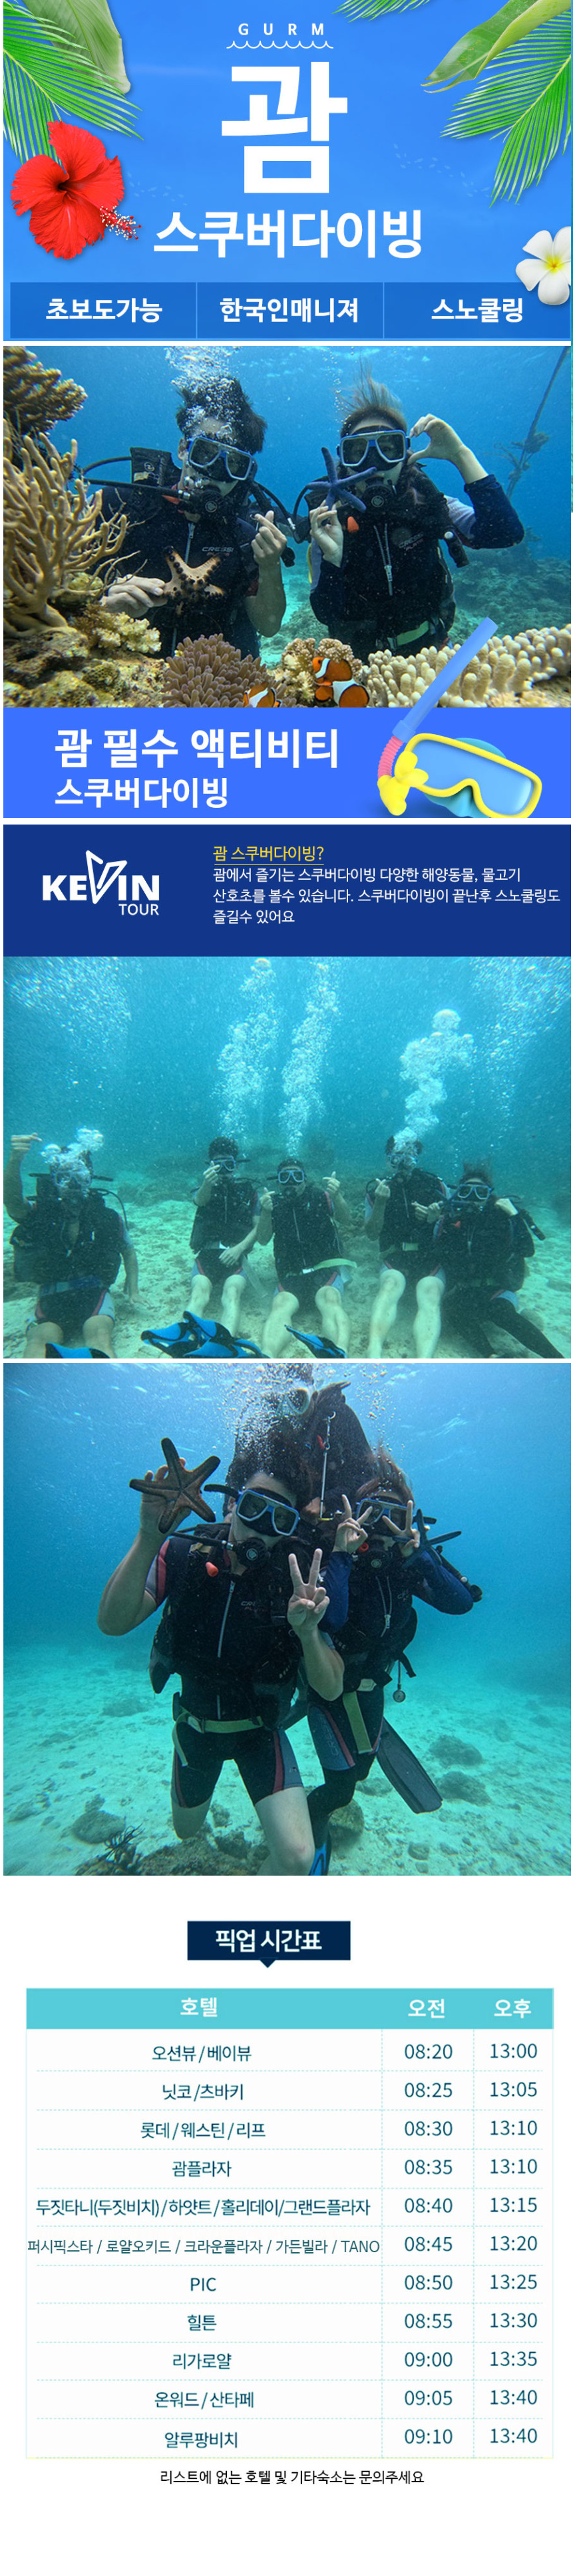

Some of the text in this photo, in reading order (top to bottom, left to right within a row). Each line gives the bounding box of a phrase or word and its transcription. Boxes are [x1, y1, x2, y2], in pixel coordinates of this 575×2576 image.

[238, 23, 324, 36] GURM
[222, 61, 348, 193] 괌
[153, 209, 422, 259] 스쿠버다이빙
[46, 297, 163, 323] 초보도가능
[220, 297, 358, 323] 한국인매니져
[431, 297, 524, 323] 스노쿨링
[55, 729, 338, 769] 괌 필수 액티비티
[55, 777, 228, 809] 스쿠버다이빙
[213, 846, 324, 862] 괌 스쿠버다이빙?
[42, 850, 160, 904] KEVIN
[213, 868, 520, 882] 괌에서 즐기는 스쿠버다이빙 다양한 해양동물, 물고기
[213, 888, 560, 904] 산호초를 볼수 있습니다. 스쿠버다이빙이 끝난후 스노쿨링도
[118, 904, 159, 916] TOUR
[213, 910, 295, 924] 즐길수 있어요
[216, 1929, 322, 1952] 픽업 시간표
[180, 1997, 218, 2017] 호텔
[407, 1999, 445, 2019] 오전
[494, 1999, 532, 2019] 오후
[404, 2043, 453, 2059] 08:20
[489, 2043, 538, 2059] 13:00
[404, 2082, 453, 2098] 08:25
[489, 2081, 538, 2097] 13:05
[404, 2121, 453, 2136] 08:30
[489, 2120, 538, 2136] 13:10
[171, 2160, 232, 2178] 괌플라자
[404, 2159, 453, 2175] 08:35
[489, 2158, 538, 2174] 13:10
[404, 2198, 453, 2214] 08:40
[489, 2197, 538, 2213] 13:15
[27, 2240, 94, 2255] 퍼시픽스타
[106, 2240, 172, 2254] 로얄오키드
[184, 2240, 263, 2255] 크라운플라자
[276, 2240, 328, 2255] 가든빌라
[340, 2240, 381, 2253] TANO
[404, 2236, 453, 2252] 08:45
[489, 2236, 538, 2252] 13:20
[190, 2277, 217, 2292] PIC
[404, 2275, 453, 2291] 08:50
[489, 2274, 538, 2290] 13:25
[187, 2314, 218, 2331] 힐튼
[404, 2313, 453, 2329] 08:55
[489, 2313, 538, 2329] 13:30
[172, 2353, 232, 2370] 리가로얄
[404, 2351, 453, 2367] 09:00
[489, 2351, 538, 2367] 13:35
[404, 2390, 453, 2406] 09:05
[489, 2389, 538, 2405] 13:40
[164, 2432, 238, 2449] 알루팡비치
[404, 2428, 453, 2444] 09:10
[489, 2428, 538, 2444] 13:40
[160, 2470, 425, 2485] 리스트에 없는 호텔 및 기타숙소는 문의주세요
